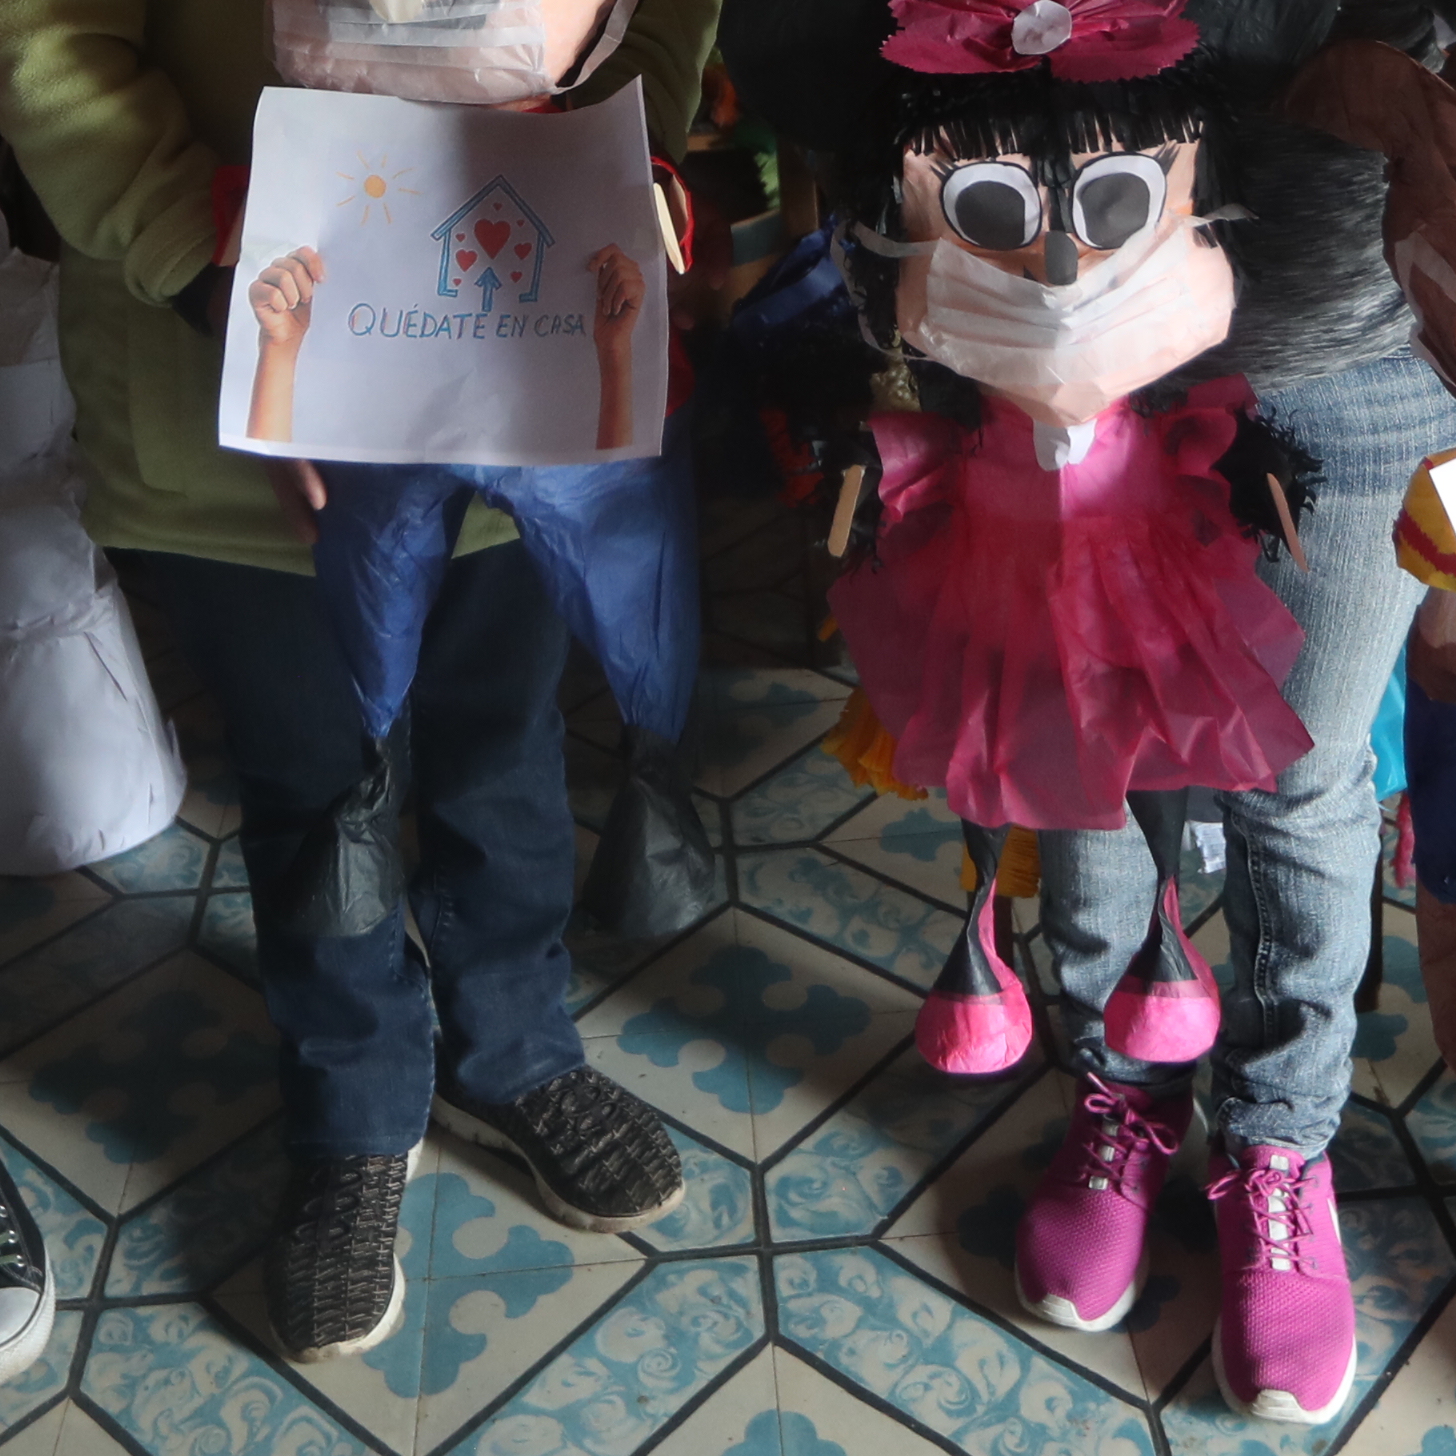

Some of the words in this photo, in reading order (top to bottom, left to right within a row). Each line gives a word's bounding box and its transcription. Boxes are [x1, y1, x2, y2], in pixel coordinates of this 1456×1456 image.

[347, 302, 487, 340] QUÉDATE
[496, 313, 530, 339] EN
[534, 313, 587, 337] CASA
